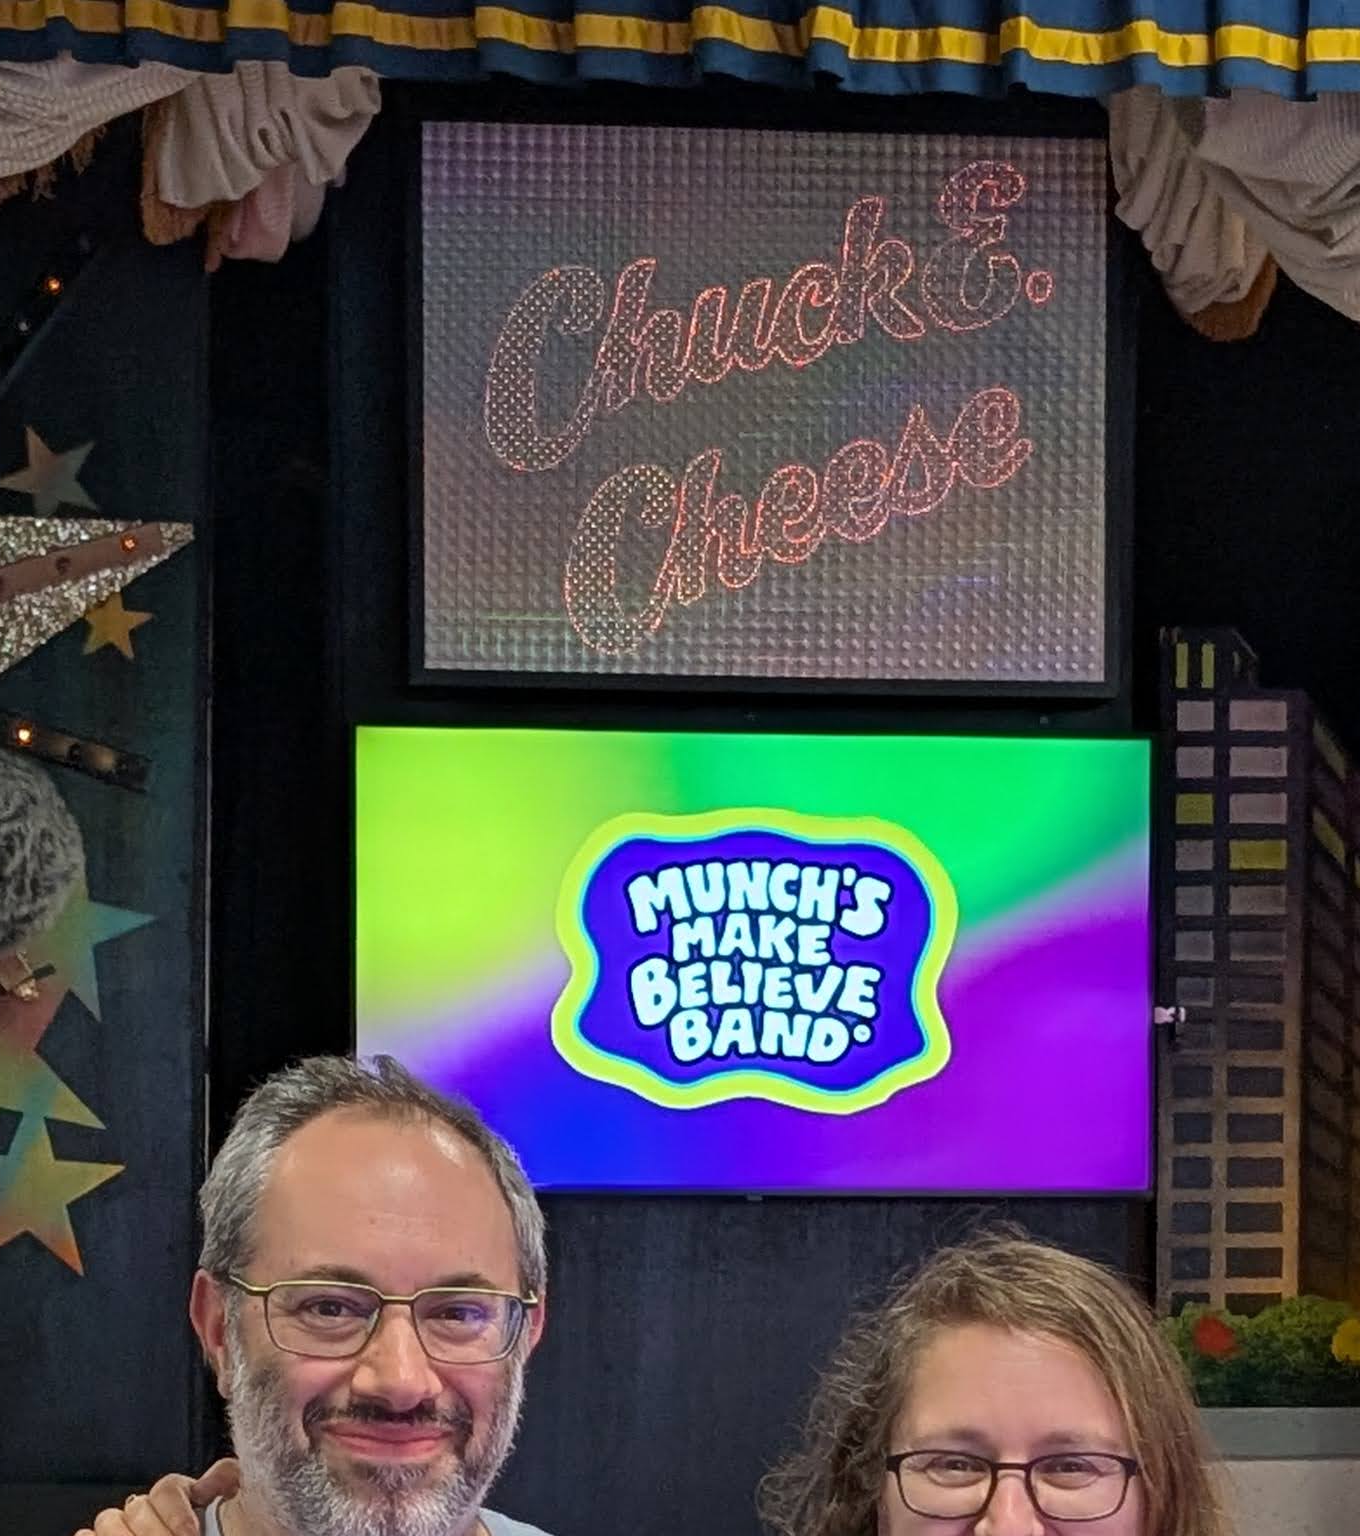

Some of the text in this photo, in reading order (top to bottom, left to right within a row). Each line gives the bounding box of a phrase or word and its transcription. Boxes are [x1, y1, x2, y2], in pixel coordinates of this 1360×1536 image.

[484, 159, 1054, 473] Chuck E.
[564, 387, 1034, 656] Cheese
[627, 861, 891, 937] MUNCH'S
[671, 913, 831, 966] MAKE
[630, 957, 881, 1027] BELIEVE
